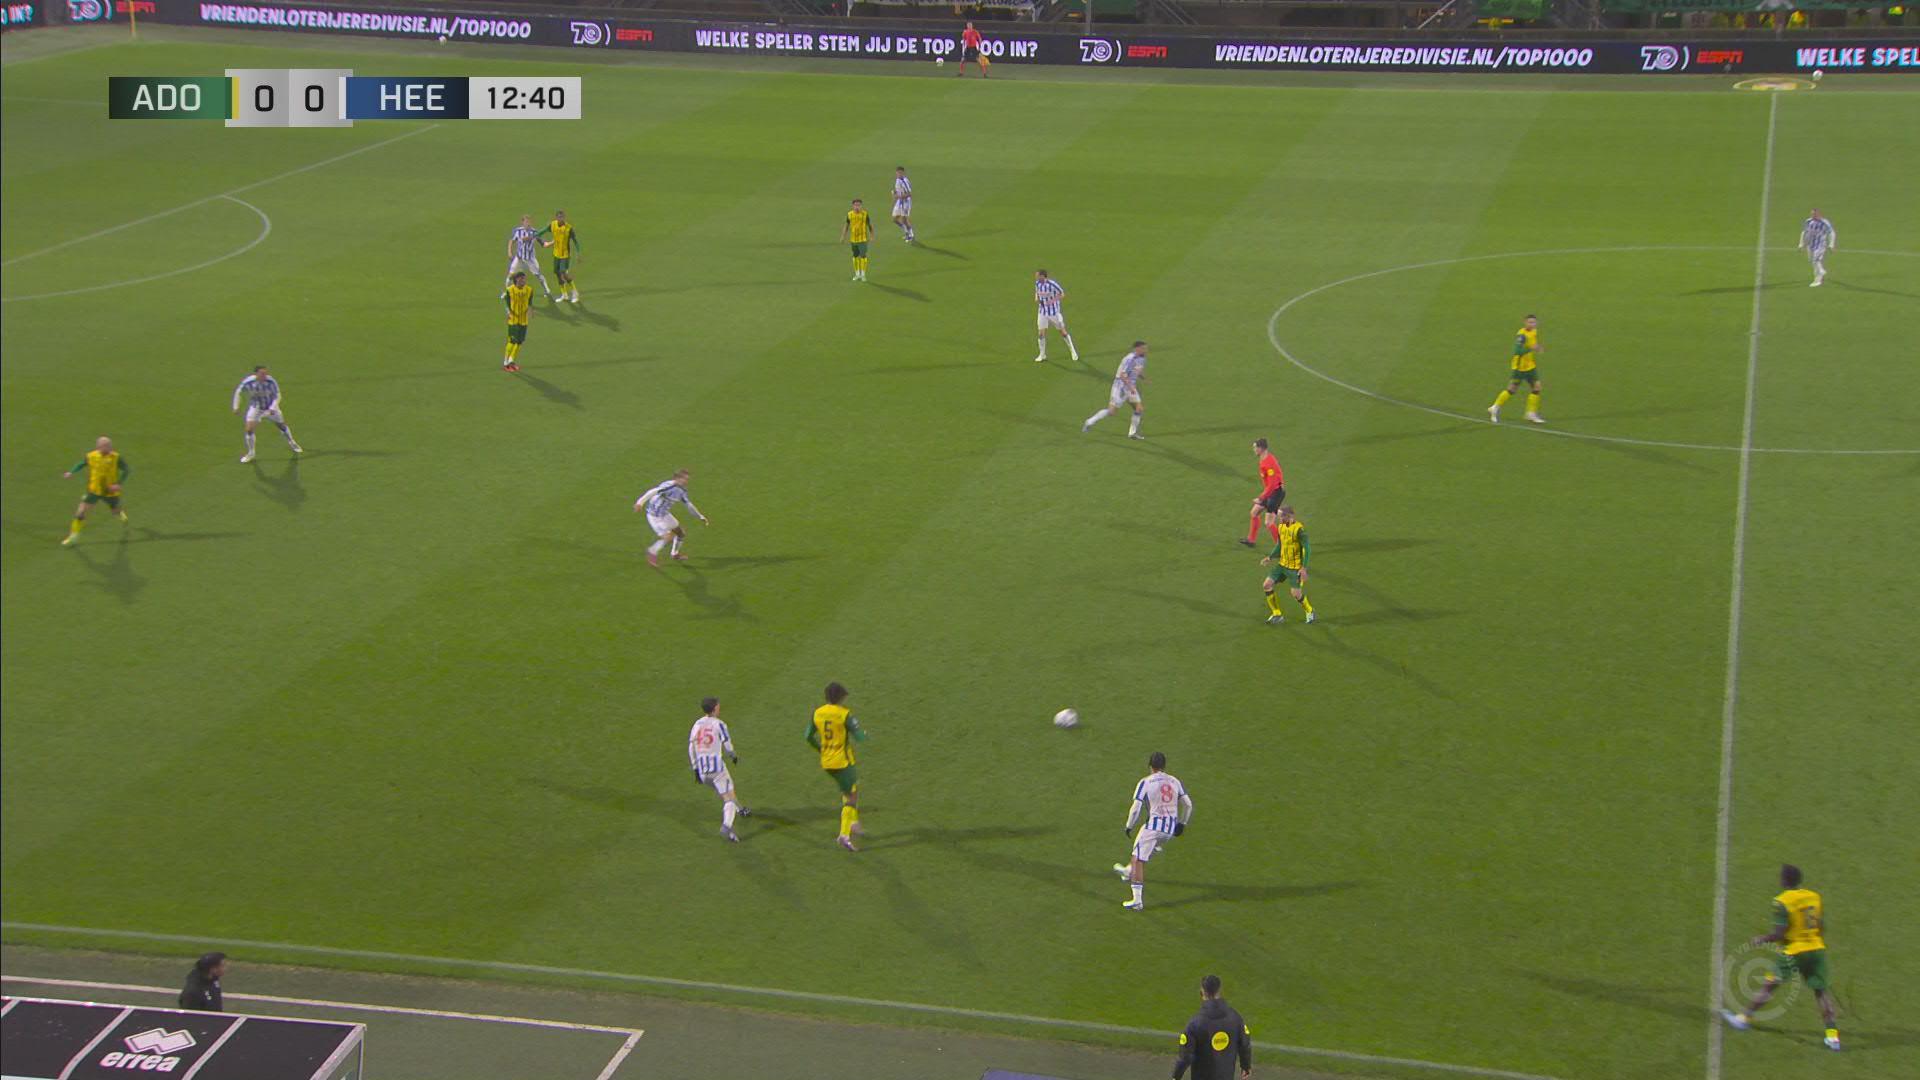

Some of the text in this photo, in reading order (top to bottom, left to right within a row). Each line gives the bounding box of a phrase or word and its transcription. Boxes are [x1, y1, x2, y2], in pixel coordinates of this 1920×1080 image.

[200, 4, 531, 39] VRIENDENLOTERIJEREDIVISIE.NL/TOP1000
[616, 28, 653, 42] ESPN
[696, 30, 1038, 58] WELKE SPELER STEM JIJ DE TOP 100 IN?
[1127, 46, 1167, 58] ESPN
[1215, 45, 1593, 68] VRIENDENLOTERIJEREDIVISIE.NL/TOP1000
[1696, 49, 1743, 64] ESPN
[1796, 48, 1865, 67] WELKE
[824, 721, 833, 740] 5
[1161, 784, 1173, 802] 8
